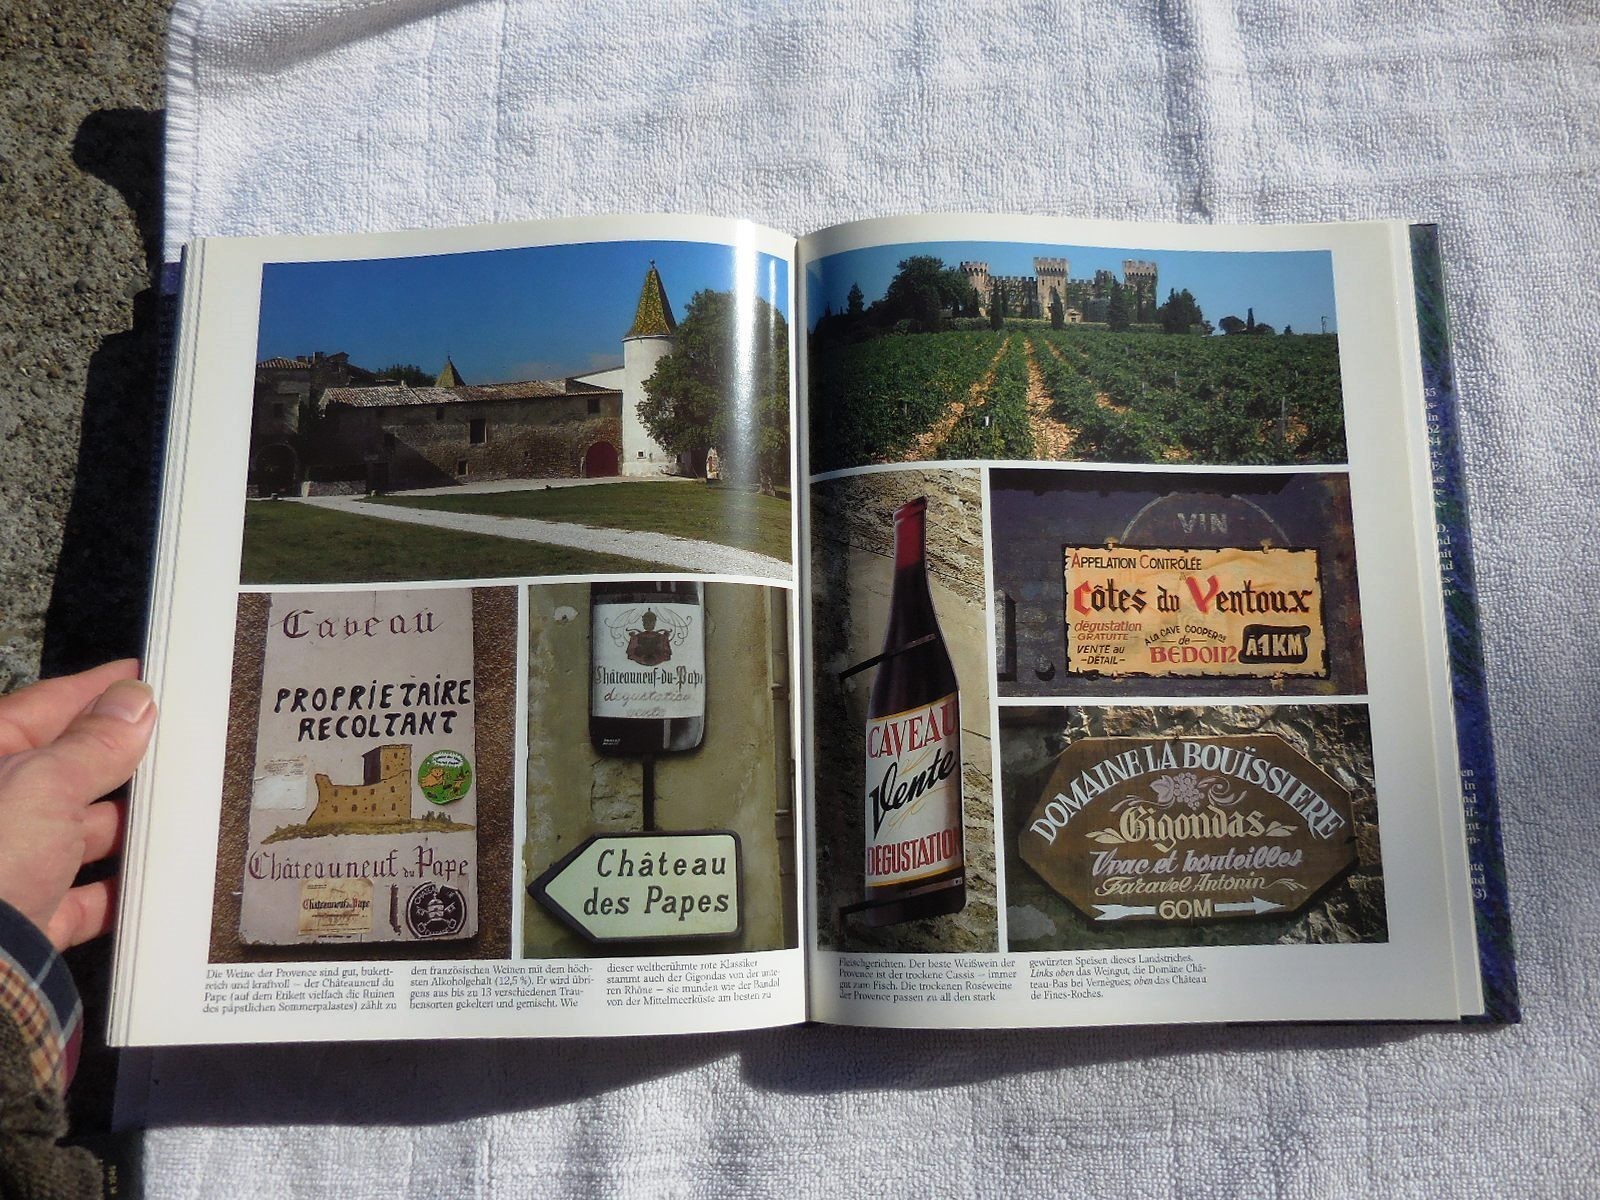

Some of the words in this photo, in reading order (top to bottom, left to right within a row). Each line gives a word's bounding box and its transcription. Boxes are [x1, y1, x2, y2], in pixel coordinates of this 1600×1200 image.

[1177, 513, 1227, 534] VIN
[1071, 552, 1136, 570] APPELATION
[1073, 578, 1147, 616] Côtes
[1157, 584, 1181, 613] du
[1185, 575, 1313, 616] Ventoux
[1074, 620, 1142, 634] dégustation
[1160, 625, 1181, 638] CAVE
[1178, 634, 1191, 646] de
[1076, 644, 1110, 654] VENTE
[1112, 645, 1126, 654] au
[297, 710, 458, 742] RECOLTANT
[868, 702, 958, 762] CAVEAU
[868, 747, 957, 842] Vente
[1030, 749, 1144, 846] DOMAINE
[1141, 740, 1178, 773] LA
[1119, 802, 1267, 852] Gigondas
[248, 849, 398, 881] Châteauneuf
[403, 865, 415, 878] du
[411, 845, 469, 882] Pape
[597, 848, 727, 878] Château
[1150, 849, 1179, 874] et
[1181, 845, 1304, 873] bouteilles
[1192, 871, 1266, 892] Antonin
[583, 887, 631, 916] des
[644, 885, 730, 922] Papes
[1159, 899, 1213, 920] 60M
[607, 963, 634, 973] dieser
[637, 961, 698, 972] weltberühmte
[701, 962, 717, 970] rote
[720, 958, 758, 969] Klassiker
[909, 959, 926, 969] Der
[927, 959, 952, 968] beste
[954, 958, 998, 968] Weißwein
[1000, 957, 1016, 968] der
[1029, 957, 1073, 969] gewürzten
[1075, 956, 1108, 968] Speisen
[1110, 955, 1136, 964] dieses
[207, 969, 222, 979] Die
[226, 968, 254, 978] Weine
[258, 968, 272, 978] der
[276, 968, 317, 978] Provence
[320, 967, 339, 977] sind
[411, 966, 427, 975] den
[430, 965, 490, 975] französischen
[493, 964, 525, 974] Weinen
[528, 965, 543, 974] mit
[545, 964, 565, 974] dem
[607, 975, 641, 984] stammt
[643, 973, 665, 983] auch
[667, 972, 682, 982] der
[685, 971, 726, 984] Gigondas
[729, 971, 744, 980] von
[747, 969, 759, 978] der
[839, 968, 874, 978] Provence
[876, 970, 886, 979] ist
[888, 969, 903, 979] der
[905, 970, 943, 979] trockene
[945, 969, 975, 979] Cassis
[988, 969, 1017, 979] immer
[1030, 968, 1054, 978] Links
[1055, 967, 1075, 976] oben
[1076, 966, 1091, 976] das
[1132, 965, 1145, 974] die
[1148, 964, 1183, 974] Domäne
[304, 979, 320, 988] der
[322, 978, 380, 988] Châteauneuf
[382, 977, 395, 987] du
[410, 978, 429, 986] sten
[431, 976, 492, 988] Alkoholgehalt
[536, 976, 547, 985] Er
[549, 975, 570, 985] wird
[607, 987, 622, 995] ren
[625, 985, 653, 995] Rhône
[667, 984, 679, 993] sie
[682, 983, 719, 993] munden
[721, 983, 736, 991] wie
[738, 981, 752, 990] der
[900, 981, 917, 991] Die
[919, 981, 963, 991] trockenen
[1071, 978, 1083, 988] bei
[1134, 976, 1152, 986] oben
[1154, 976, 1170, 985] das
[1171, 975, 1207, 985] Château
[204, 992, 227, 1003] Pape
[252, 991, 272, 1001] dem
[276, 990, 305, 1000] Etikett
[308, 989, 343, 999] vielfach
[363, 988, 395, 998] Ruinen
[410, 990, 430, 1000] gens
[433, 990, 449, 998] aus
[451, 988, 465, 998] bis
[467, 990, 478, 998] zu
[481, 987, 492, 997] 13
[494, 987, 557, 997] verschiedenen
[607, 998, 623, 1007] von
[626, 996, 641, 1006] der
[643, 994, 715, 1006] Mittelmeerküste
[733, 991, 760, 1001] besten
[853, 990, 891, 1001] Provence
[893, 993, 923, 1003] passen
[940, 992, 951, 1002] all
[953, 991, 970, 1001] den
[972, 991, 996, 1001] stark
[1031, 990, 1041, 1000] de
[202, 1003, 219, 1013] des
[361, 1000, 382, 1010] zählt
[385, 1002, 397, 1010] zu
[409, 999, 453, 1009] bensorten
[455, 998, 494, 1011] gekeltert
[496, 999, 514, 1008] und
[560, 997, 578, 1007] Wie
